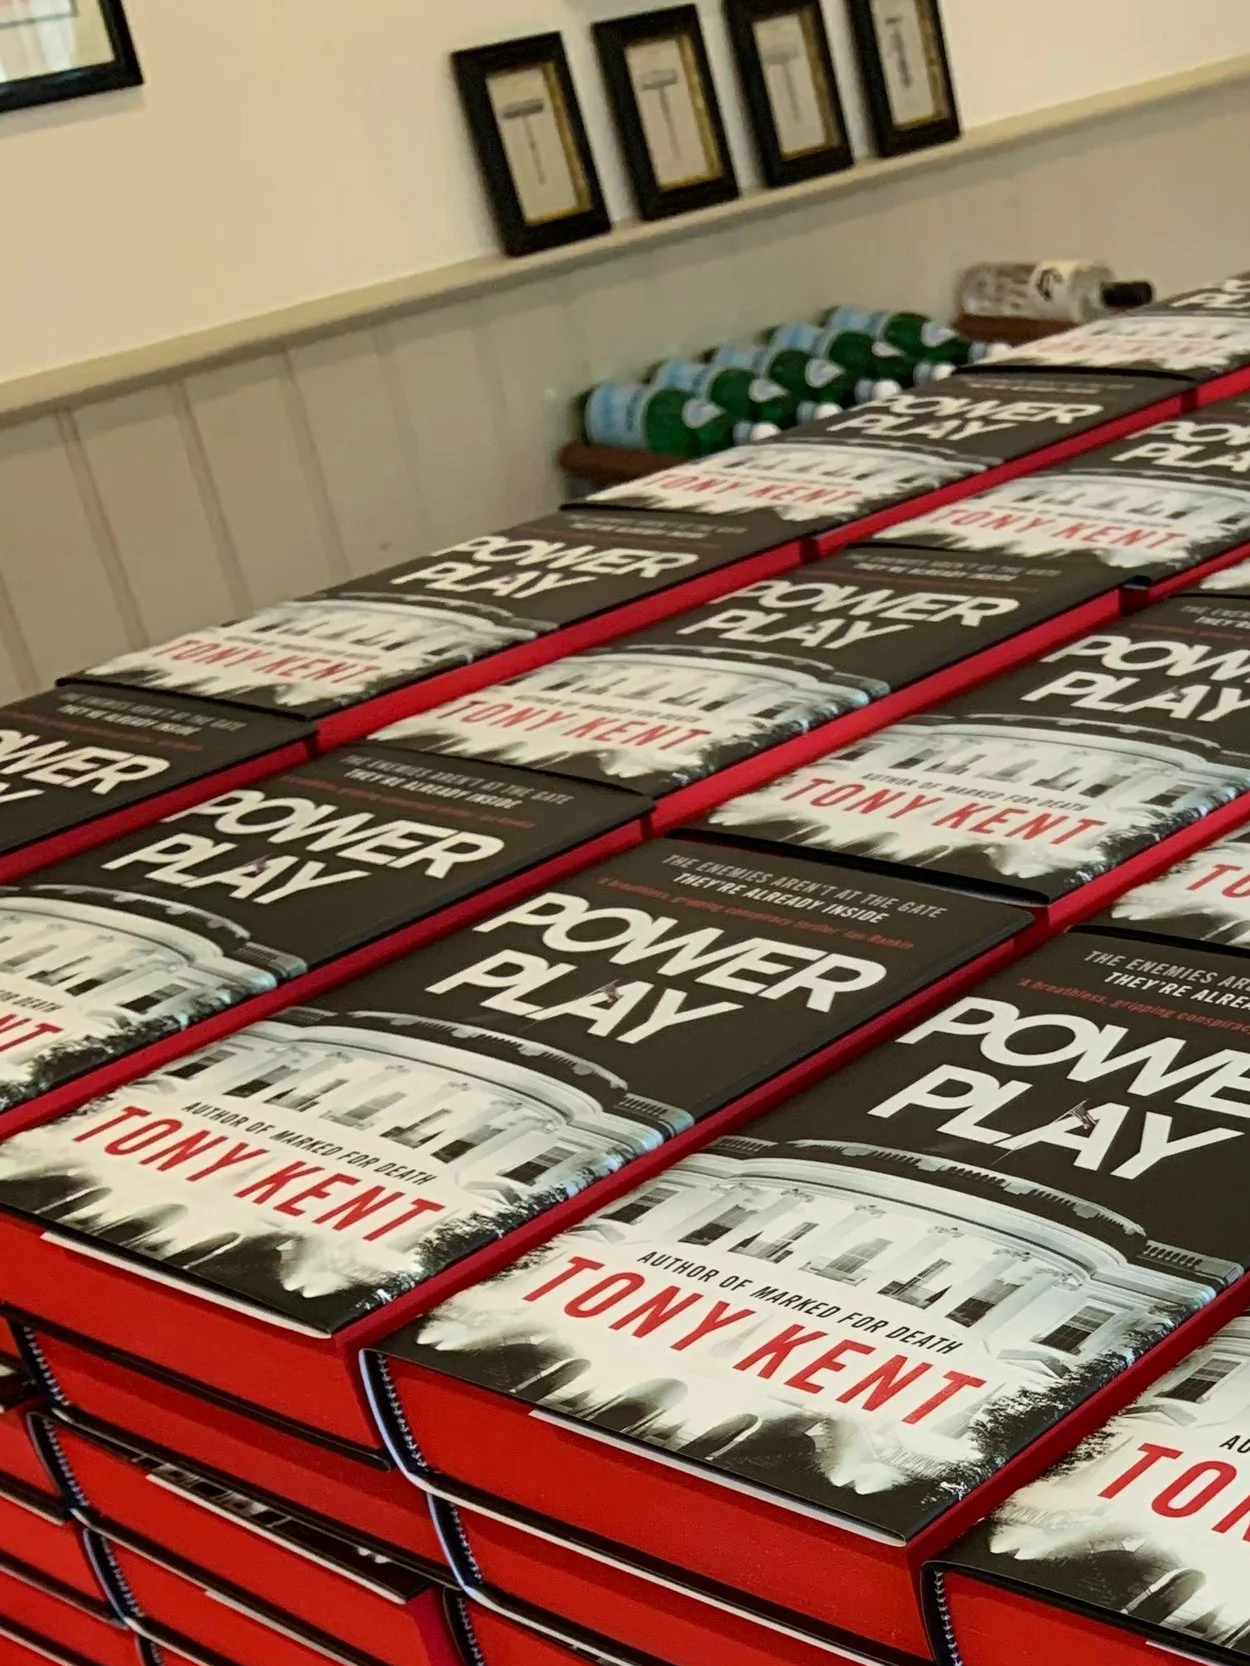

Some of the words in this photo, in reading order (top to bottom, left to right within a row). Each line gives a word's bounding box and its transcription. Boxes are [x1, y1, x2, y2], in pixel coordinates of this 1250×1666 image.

[827, 414, 1018, 439] PLAY
[642, 474, 754, 493] TONY
[741, 484, 863, 504] KENT
[930, 509, 1057, 532] TONY
[1048, 522, 1188, 547] KENT
[390, 562, 598, 597] PLAY
[429, 536, 697, 577] POWER
[709, 580, 1019, 625] POWER
[678, 609, 914, 649] PLAY
[150, 640, 275, 666] TONY
[251, 655, 384, 682] KENT
[438, 700, 579, 730] TONY
[559, 717, 712, 749] KENT
[160, 788, 504, 877] POWER
[780, 779, 943, 818] TONY
[930, 802, 1108, 843] KENT
[102, 834, 370, 904] PLAY
[476, 892, 886, 1012] POWER
[1085, 952, 1124, 965] THE
[1125, 960, 1216, 983] ENEMIES
[426, 950, 744, 1044] PLAY
[1104, 972, 1191, 995] THEY'RE
[181, 1103, 247, 1127] AUTHOR
[244, 1122, 274, 1133] OF
[268, 1131, 342, 1155] MARKED
[336, 1151, 379, 1167] FOR
[373, 1163, 437, 1184] DEATH
[869, 1065, 1245, 1179] PLAY
[72, 1107, 267, 1181] TONY
[234, 1160, 447, 1240] KENT
[637, 1253, 718, 1282] AUTHOR
[718, 1276, 751, 1290] OF
[749, 1286, 839, 1317] MARKED
[837, 1312, 888, 1332] FOR
[886, 1327, 963, 1354] DEATH
[524, 1257, 754, 1349] TONY
[733, 1323, 988, 1423] KENT
